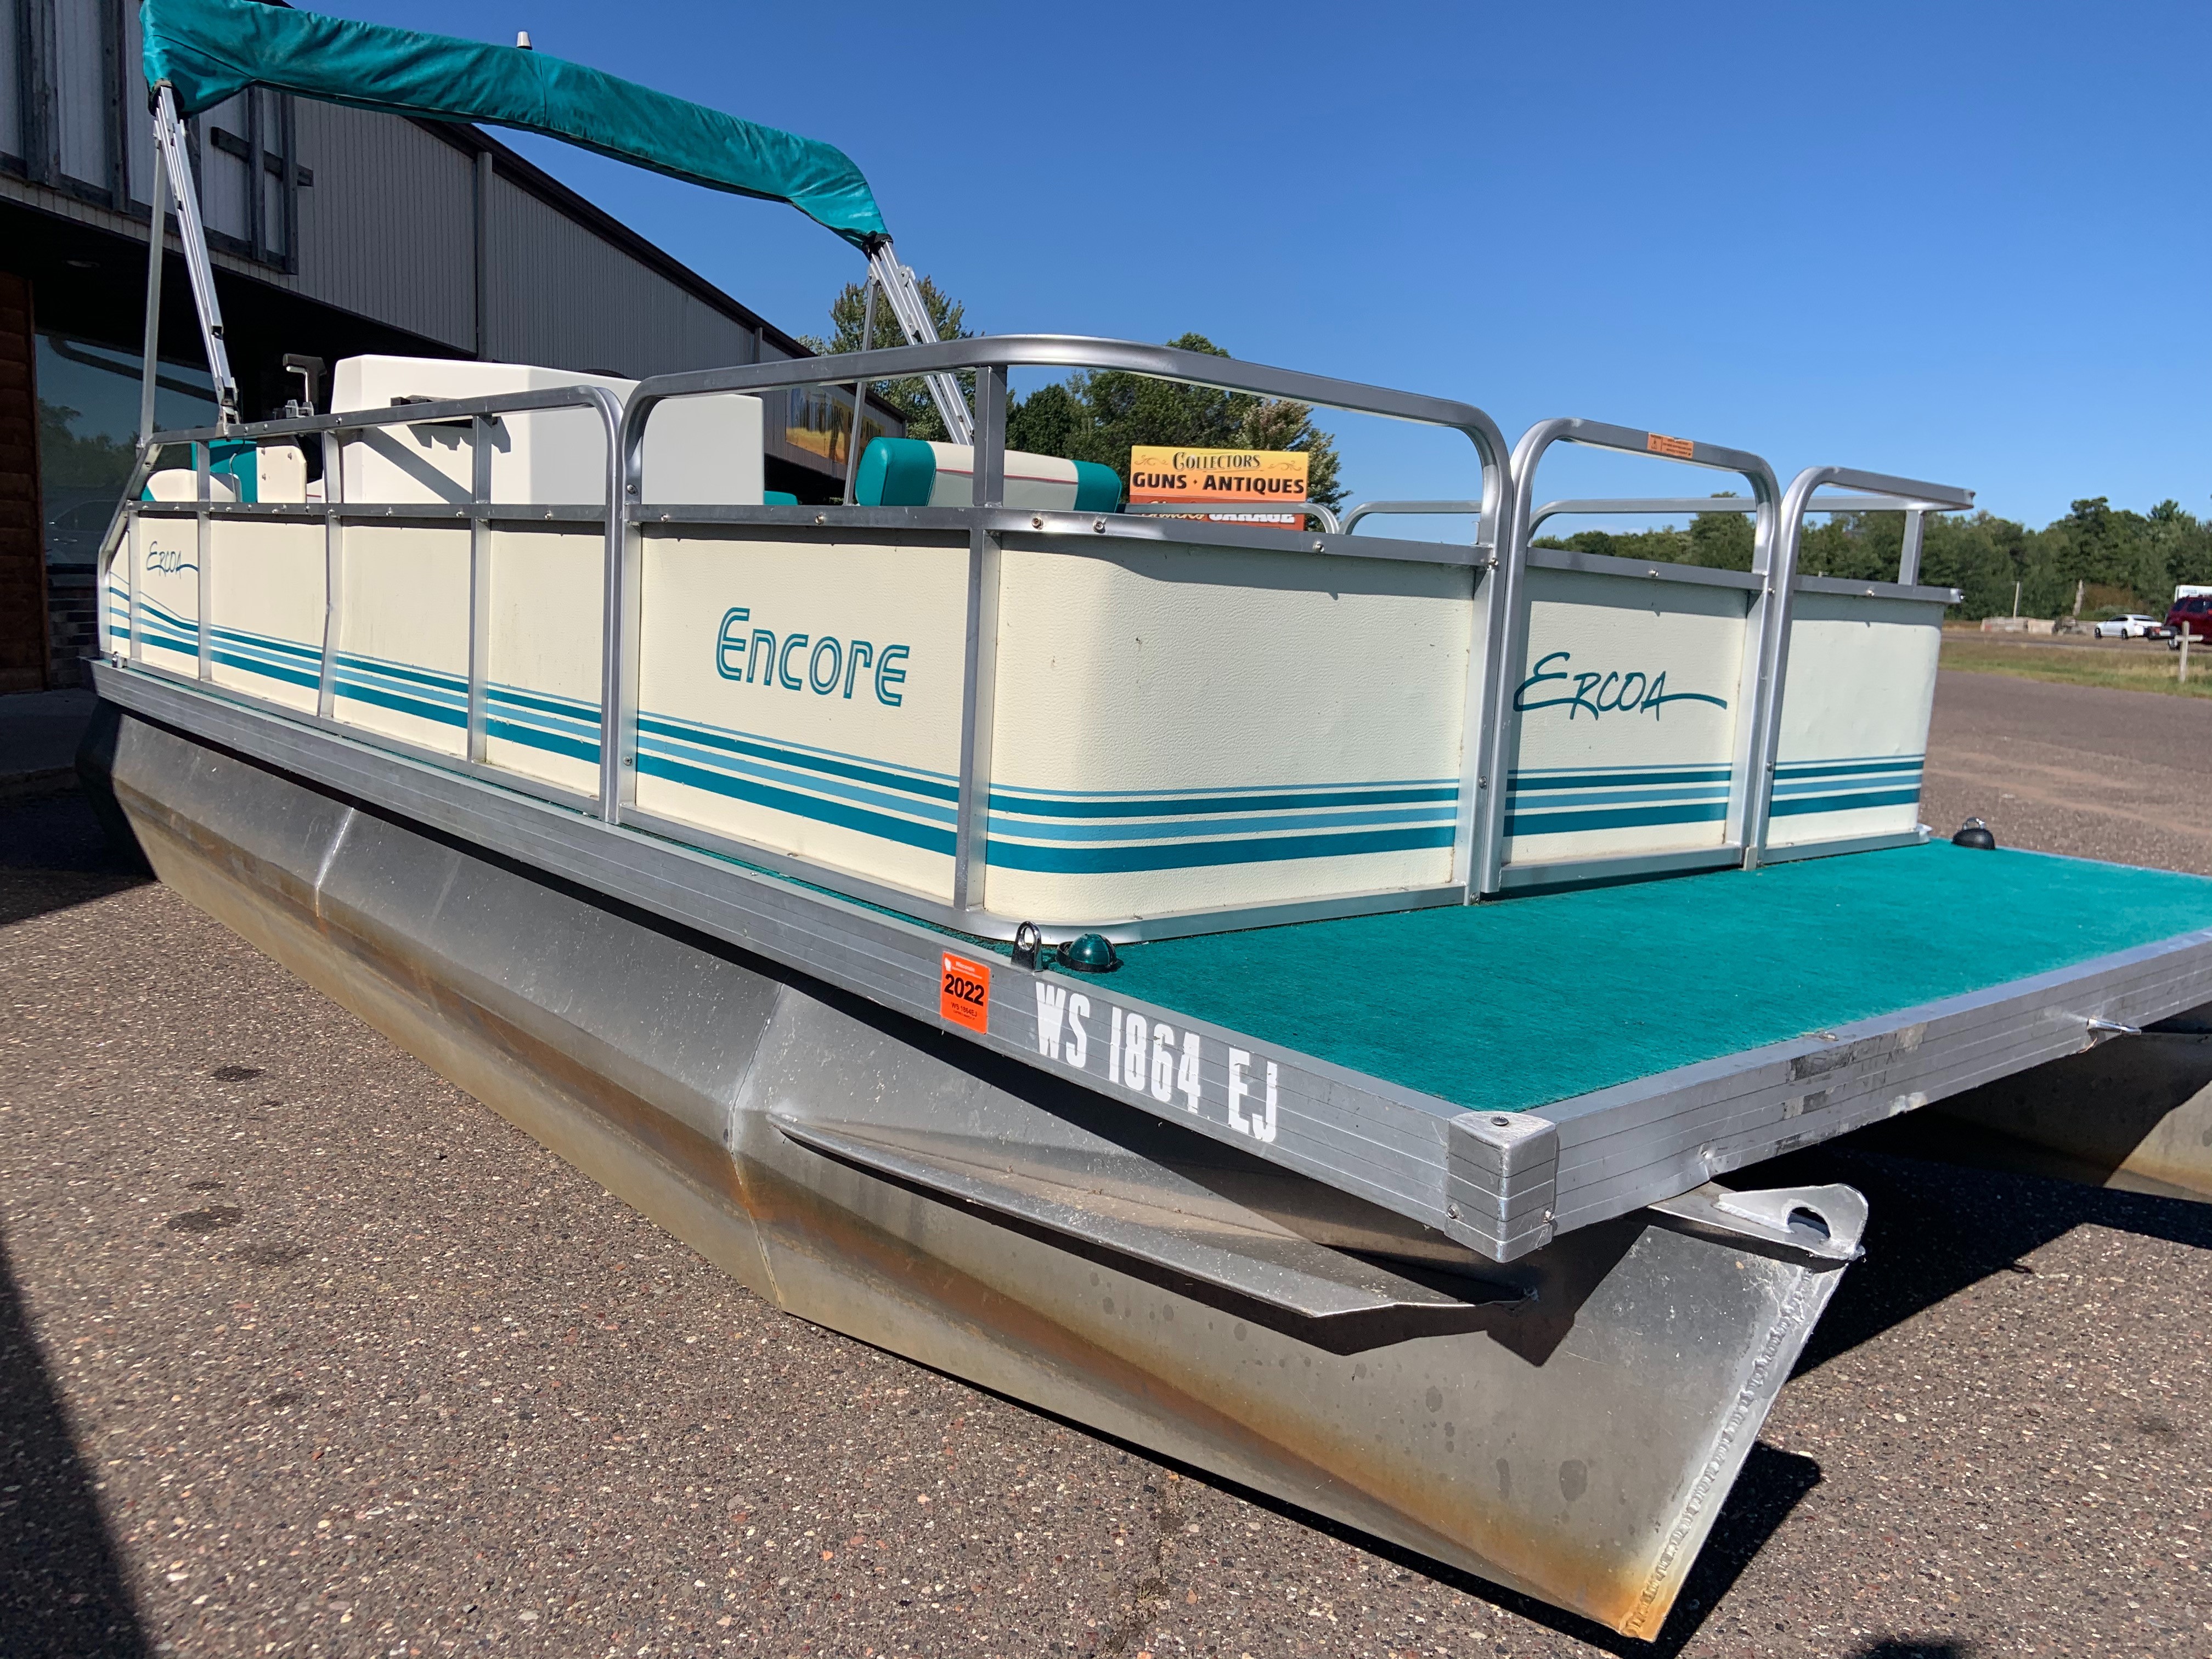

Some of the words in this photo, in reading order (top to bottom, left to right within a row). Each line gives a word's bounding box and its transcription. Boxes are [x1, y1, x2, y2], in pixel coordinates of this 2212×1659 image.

[1172, 452, 1261, 471] COLLECTORS
[1132, 472, 1187, 489] GUNS
[1202, 475, 1304, 495] ANTIQUES
[944, 973, 985, 1007] 2022
[1036, 981, 1090, 1068] WS
[1109, 1006, 1201, 1114] 1864
[1228, 1047, 1278, 1143] EJ
